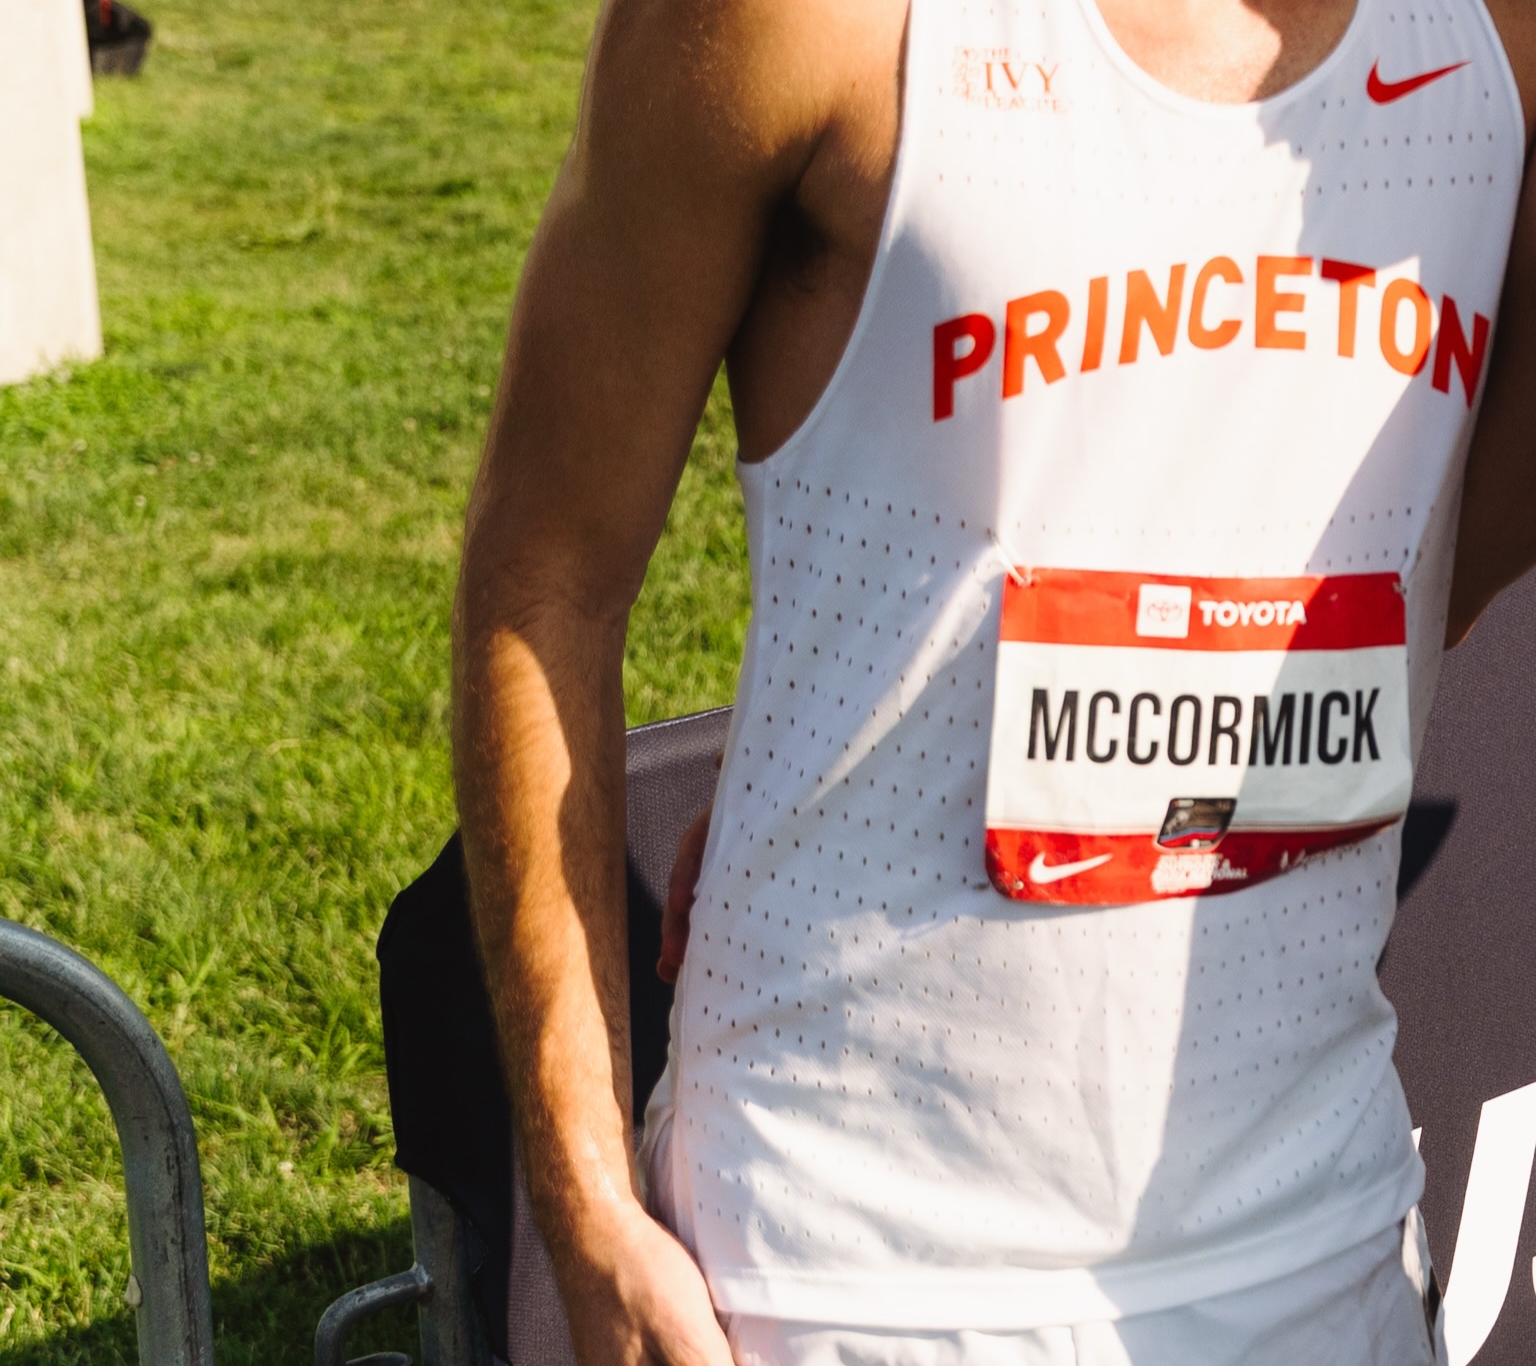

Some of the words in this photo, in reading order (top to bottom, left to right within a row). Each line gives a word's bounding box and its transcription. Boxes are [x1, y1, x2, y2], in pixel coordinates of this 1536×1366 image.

[984, 61, 1060, 92] IVY
[932, 254, 1492, 424] PRINCETON
[1198, 600, 1307, 627] TOYOTA
[1026, 687, 1382, 767] MCCORMICK
